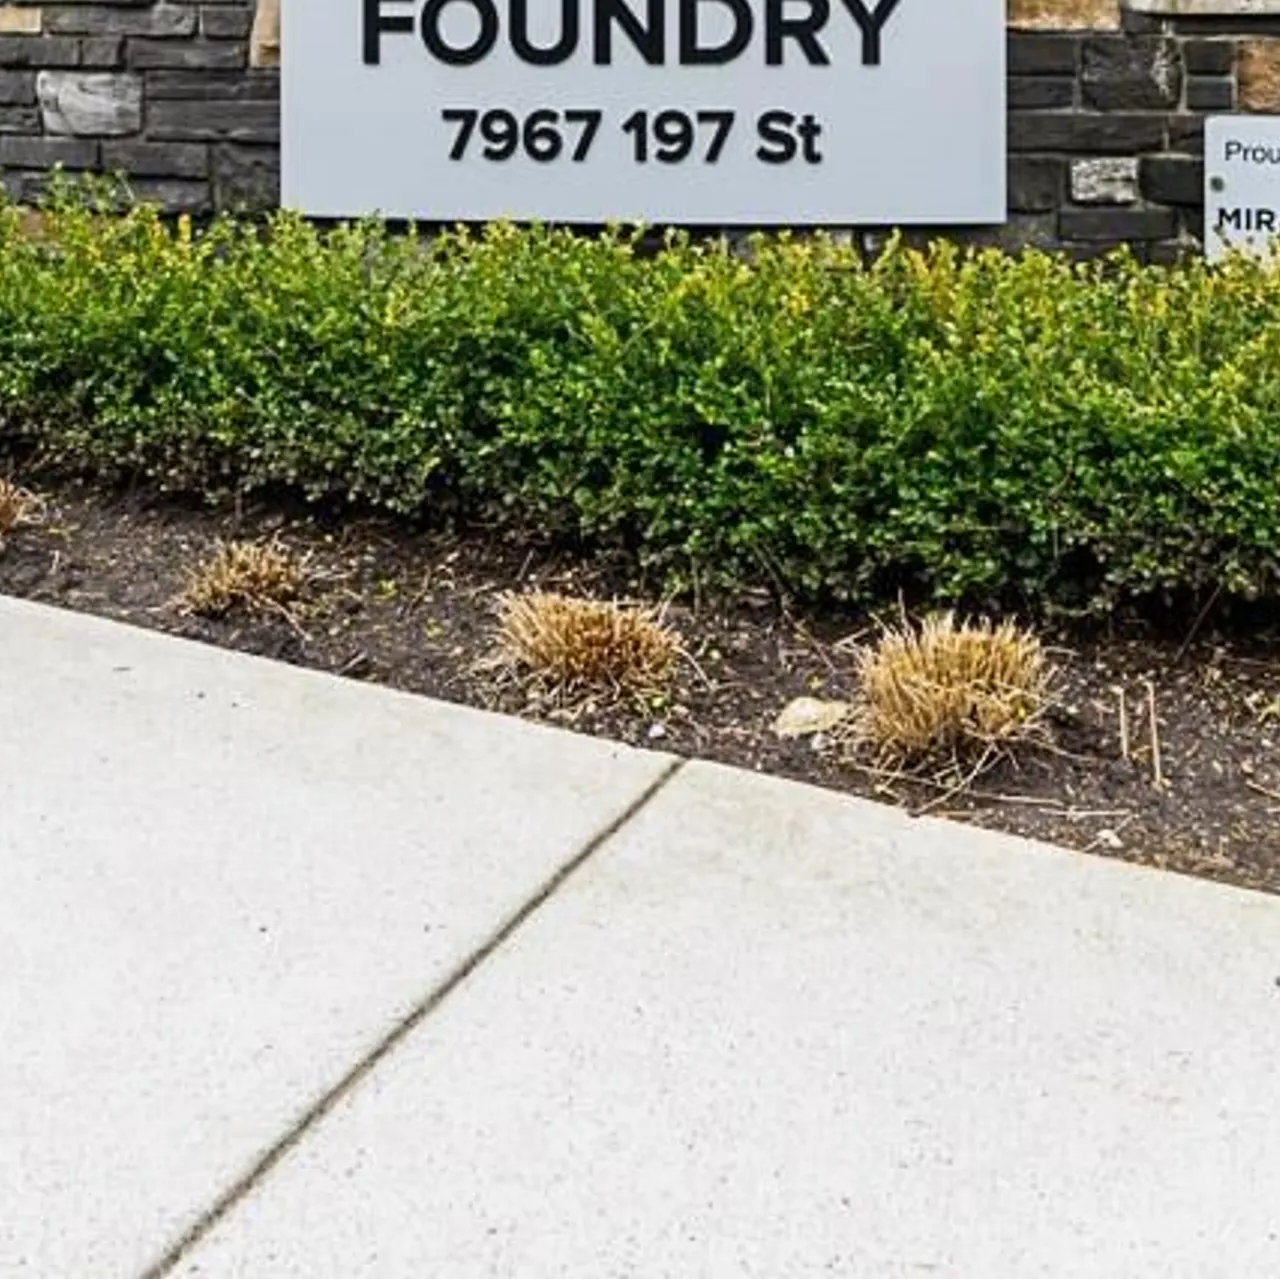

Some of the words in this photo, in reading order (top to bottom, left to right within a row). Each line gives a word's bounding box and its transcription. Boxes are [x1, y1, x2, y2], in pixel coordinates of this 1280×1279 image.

[441, 109, 603, 163] 7967
[621, 109, 735, 164] 197
[755, 109, 823, 165] St
